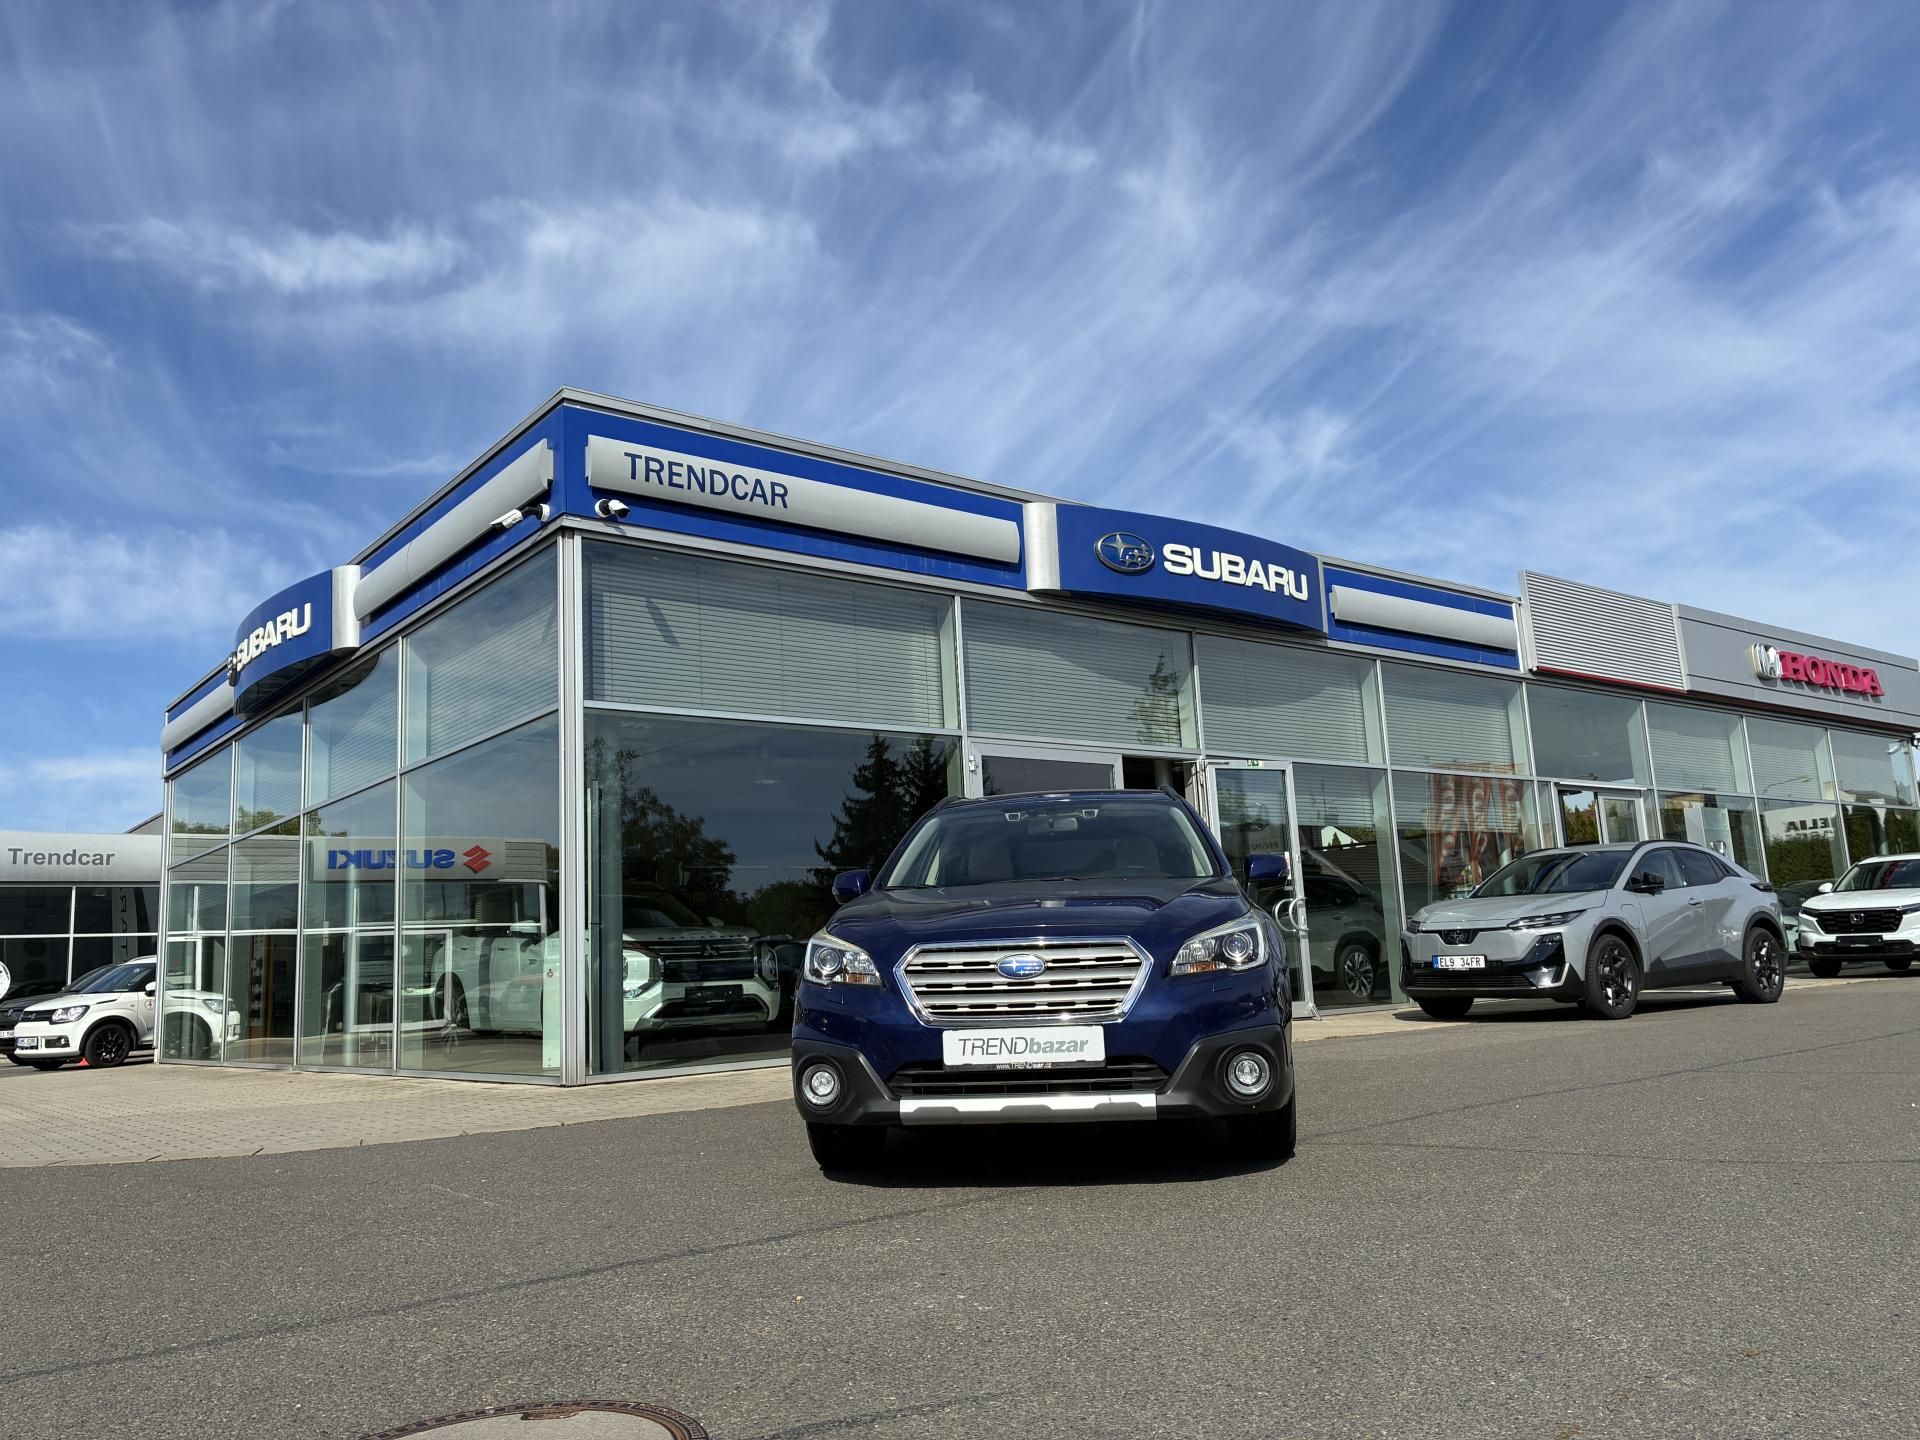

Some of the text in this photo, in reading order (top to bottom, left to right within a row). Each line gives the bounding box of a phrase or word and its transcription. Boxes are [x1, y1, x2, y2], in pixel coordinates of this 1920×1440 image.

[624, 452, 788, 509] TRENDCAR
[1162, 543, 1309, 601] SUBARU
[236, 602, 311, 672] SUBARU
[1777, 651, 1885, 696] HONDA
[8, 848, 115, 866] Trendcar
[1439, 957, 1481, 967] EL9 34FR
[958, 1036, 1089, 1056] TRENDbazar
